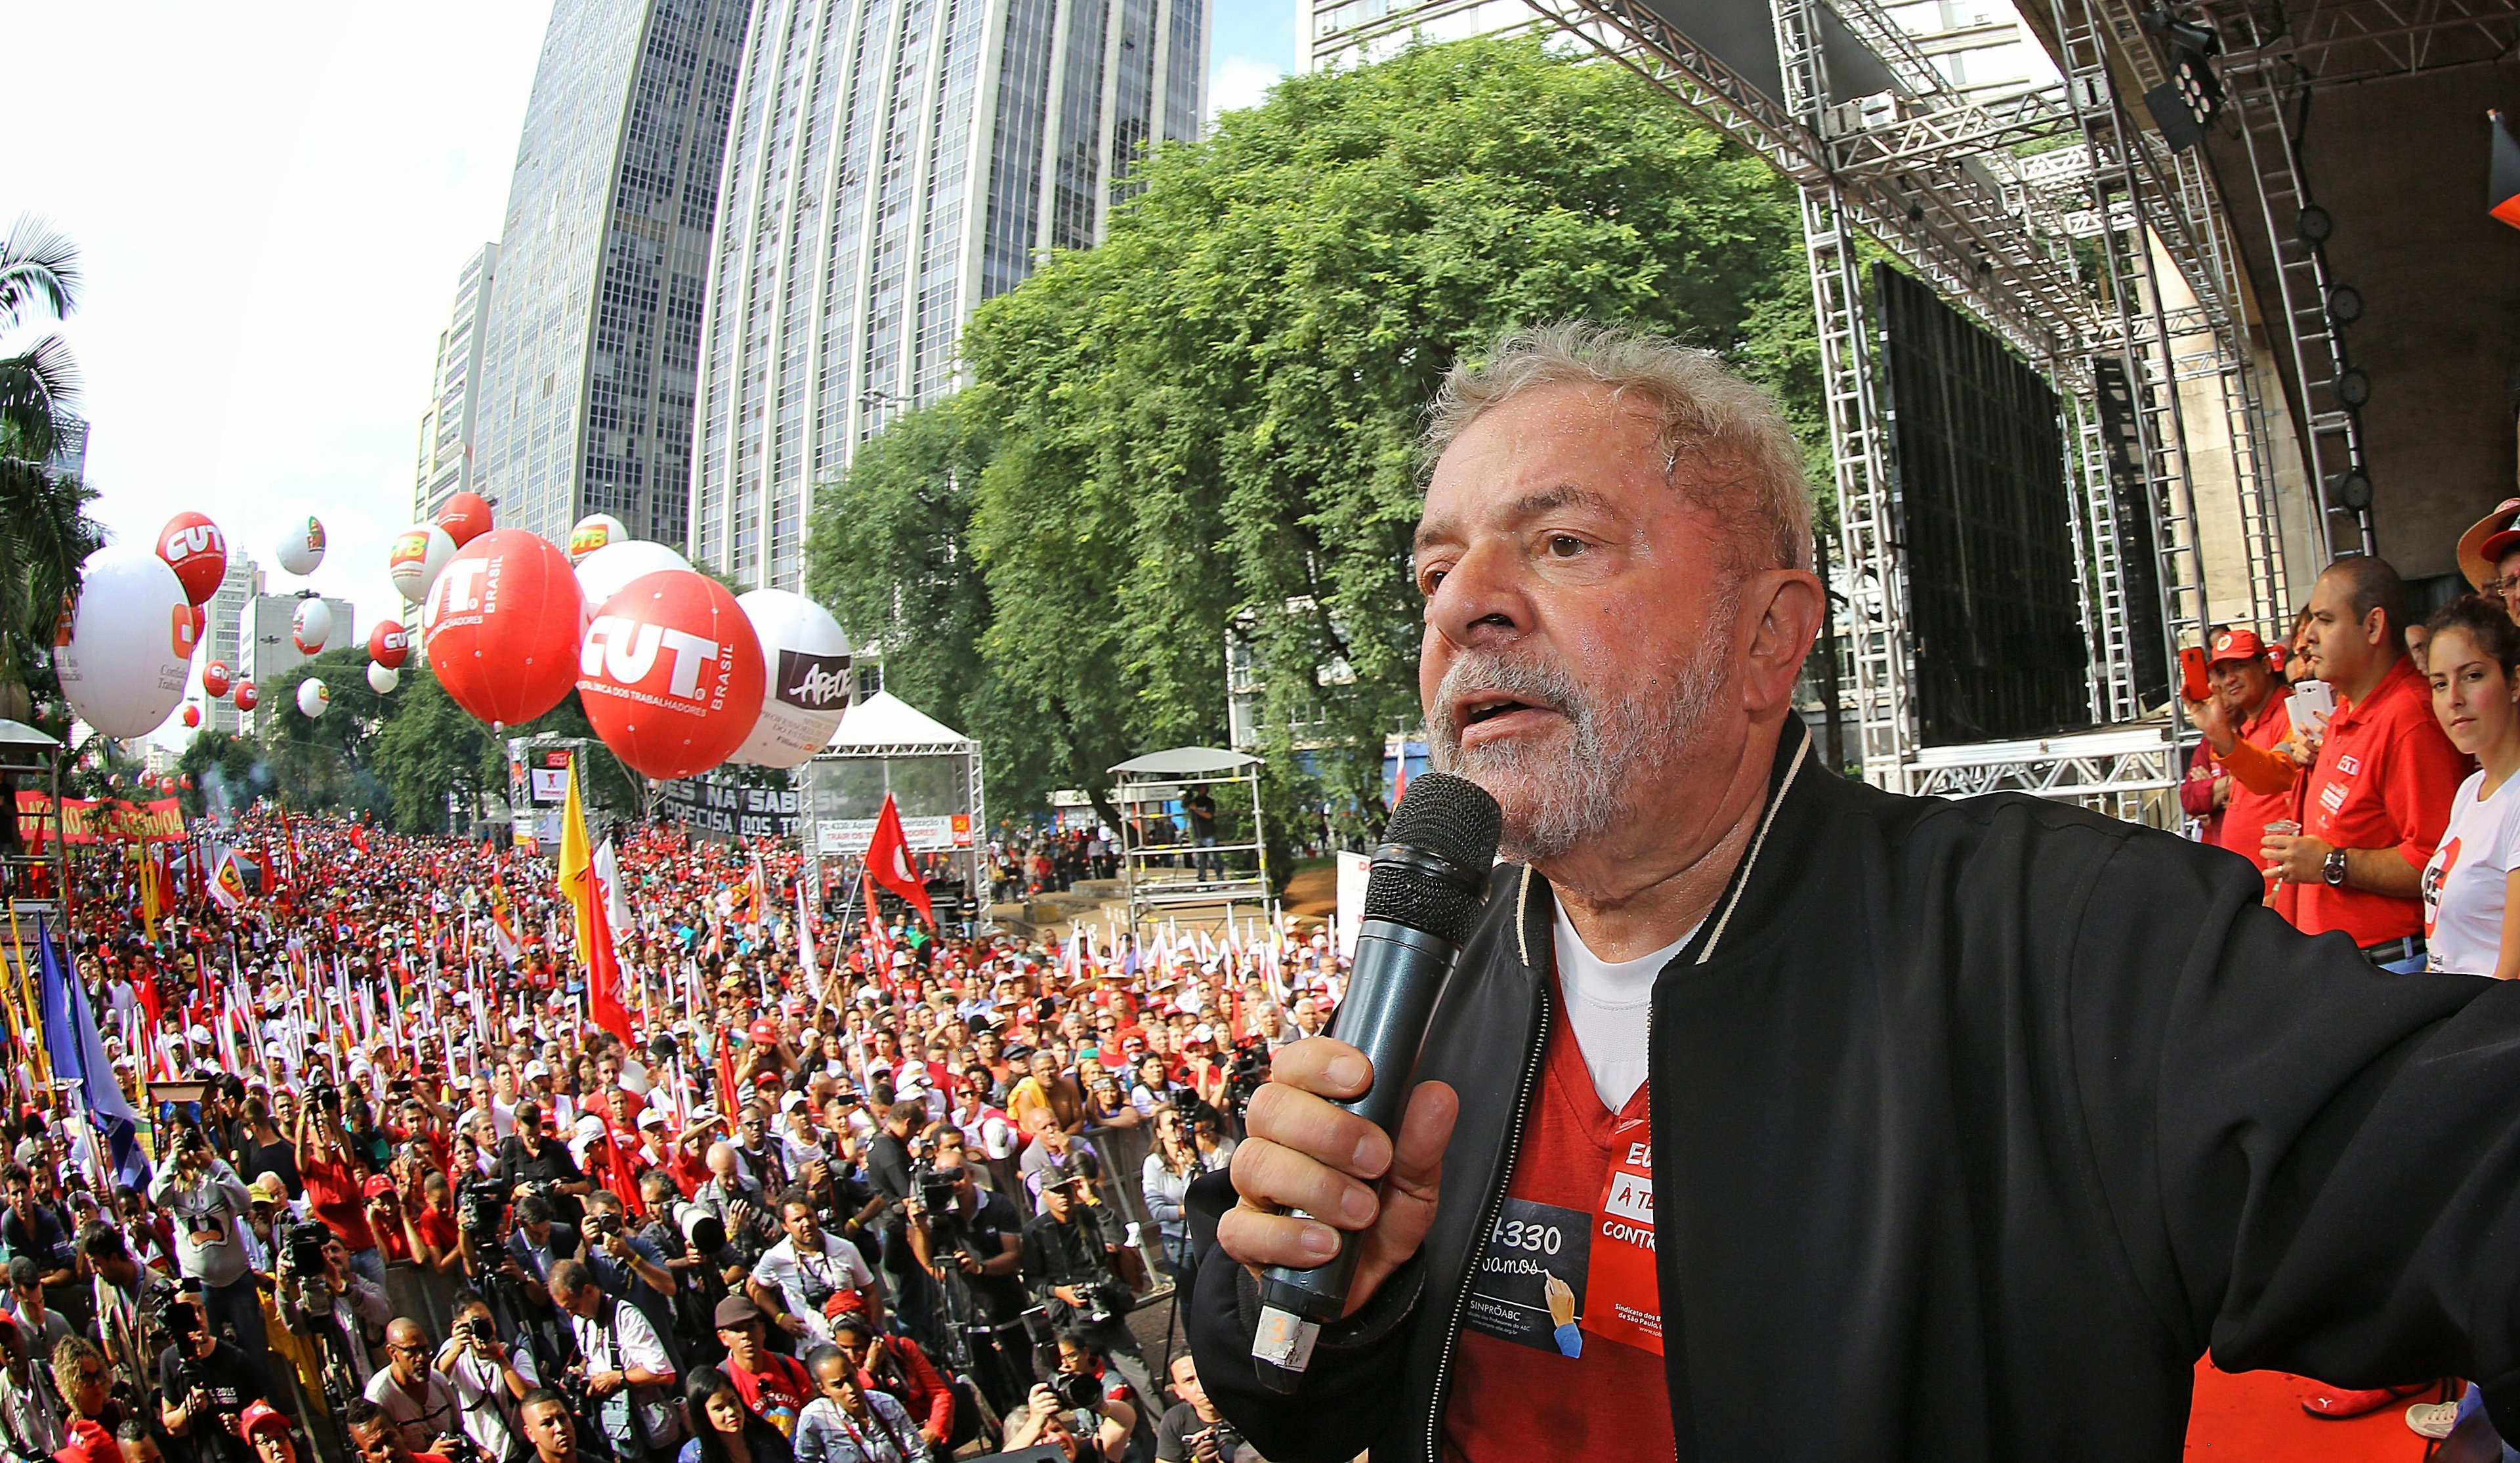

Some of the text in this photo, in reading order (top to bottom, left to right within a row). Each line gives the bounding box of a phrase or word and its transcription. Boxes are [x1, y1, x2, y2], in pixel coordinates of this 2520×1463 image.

[166, 524, 224, 562] CUT
[392, 536, 427, 557] TB
[424, 558, 489, 628] UT
[484, 555, 503, 613] BRASIL
[581, 616, 719, 698] CUT
[710, 643, 734, 710] BRASIL
[631, 690, 707, 717] TRABALHADORES
[706, 786, 738, 809] NA
[664, 800, 734, 833] PRECISA
[741, 815, 772, 837] DOS
[1618, 1181, 1632, 1207] À
[1615, 1303, 1643, 1317] Sindicato
[1627, 1315, 1639, 1323] São
[1270, 1317, 1285, 1343] 3
